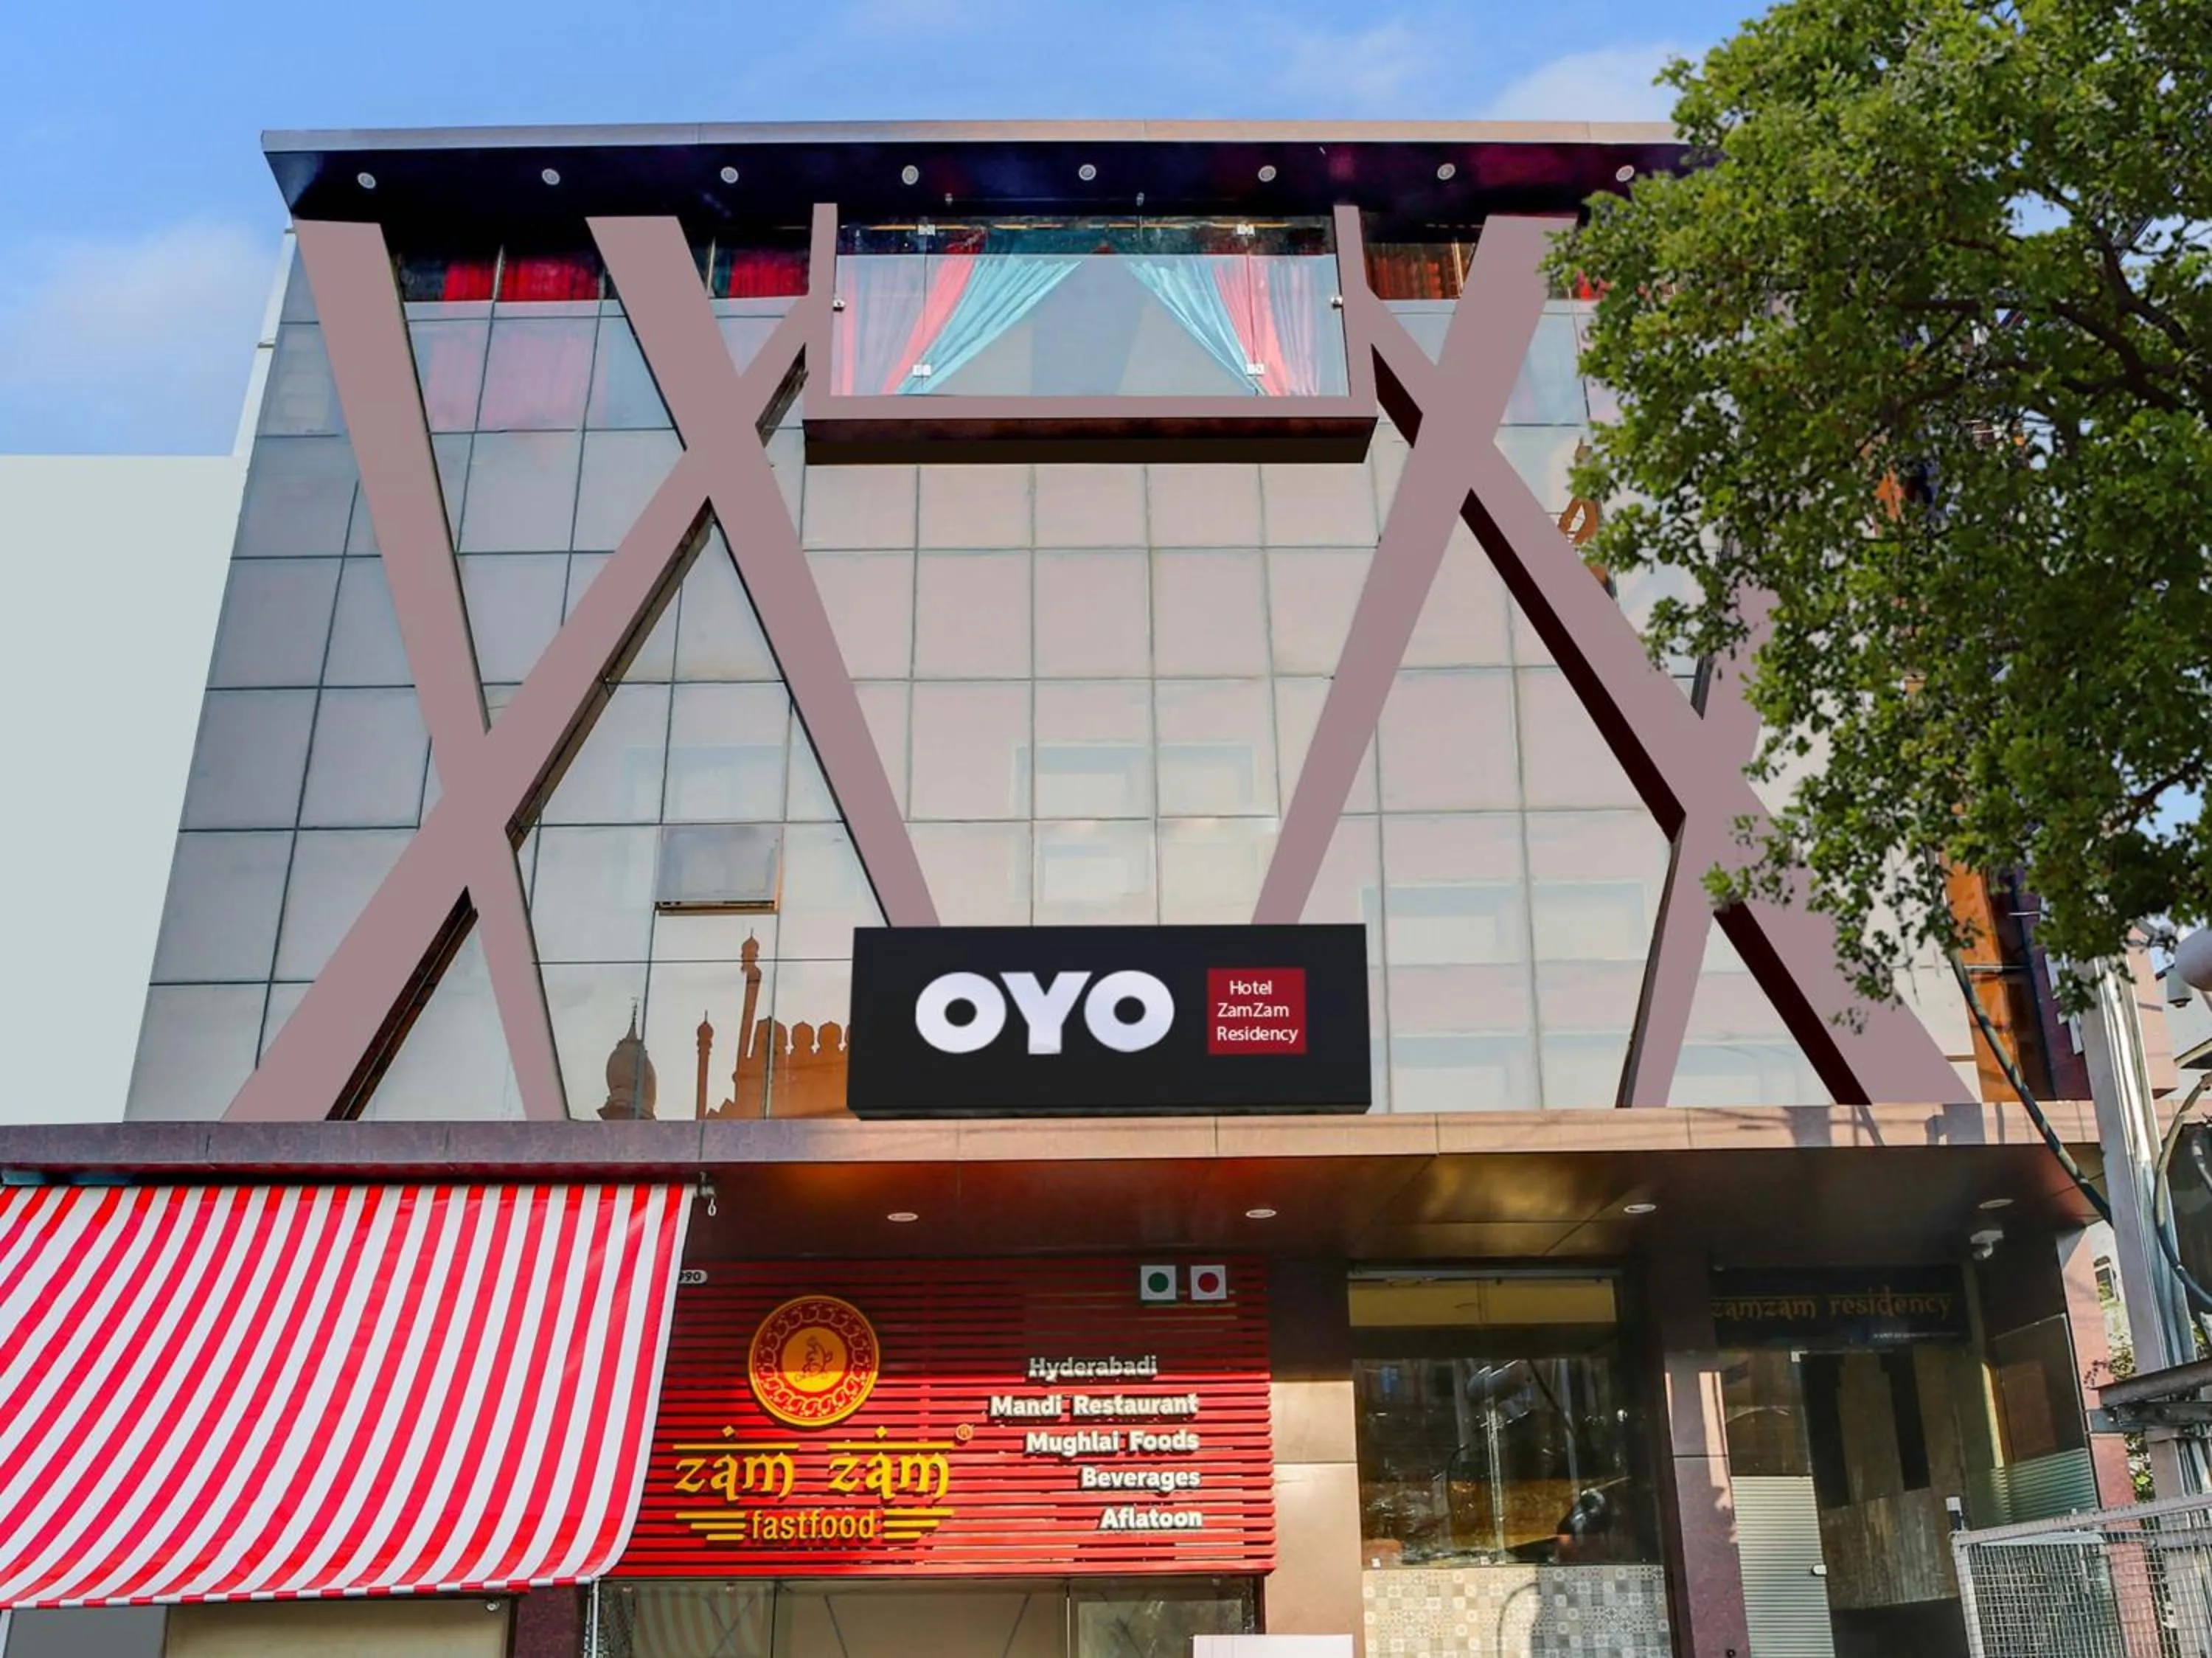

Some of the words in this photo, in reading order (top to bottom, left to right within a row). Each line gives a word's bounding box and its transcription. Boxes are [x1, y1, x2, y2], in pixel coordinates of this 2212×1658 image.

[1229, 979, 1273, 995] Hotel
[915, 970, 1175, 1054] OYO
[1217, 1002, 1290, 1017] ZamZam
[1217, 1026, 1298, 1044] Residency
[1829, 1284, 1953, 1321] residency
[1028, 1356, 1157, 1382] Hyderabadi
[990, 1395, 1062, 1417] Mandi
[1072, 1392, 1200, 1416] Restaurant
[1025, 1430, 1120, 1457] Mughlai
[1128, 1429, 1200, 1452] Foods
[674, 1452, 795, 1502] zam
[827, 1451, 950, 1500] zam
[1081, 1466, 1201, 1492] Beverages
[751, 1509, 876, 1540] fastfood
[1099, 1507, 1203, 1530] Aflatoon
